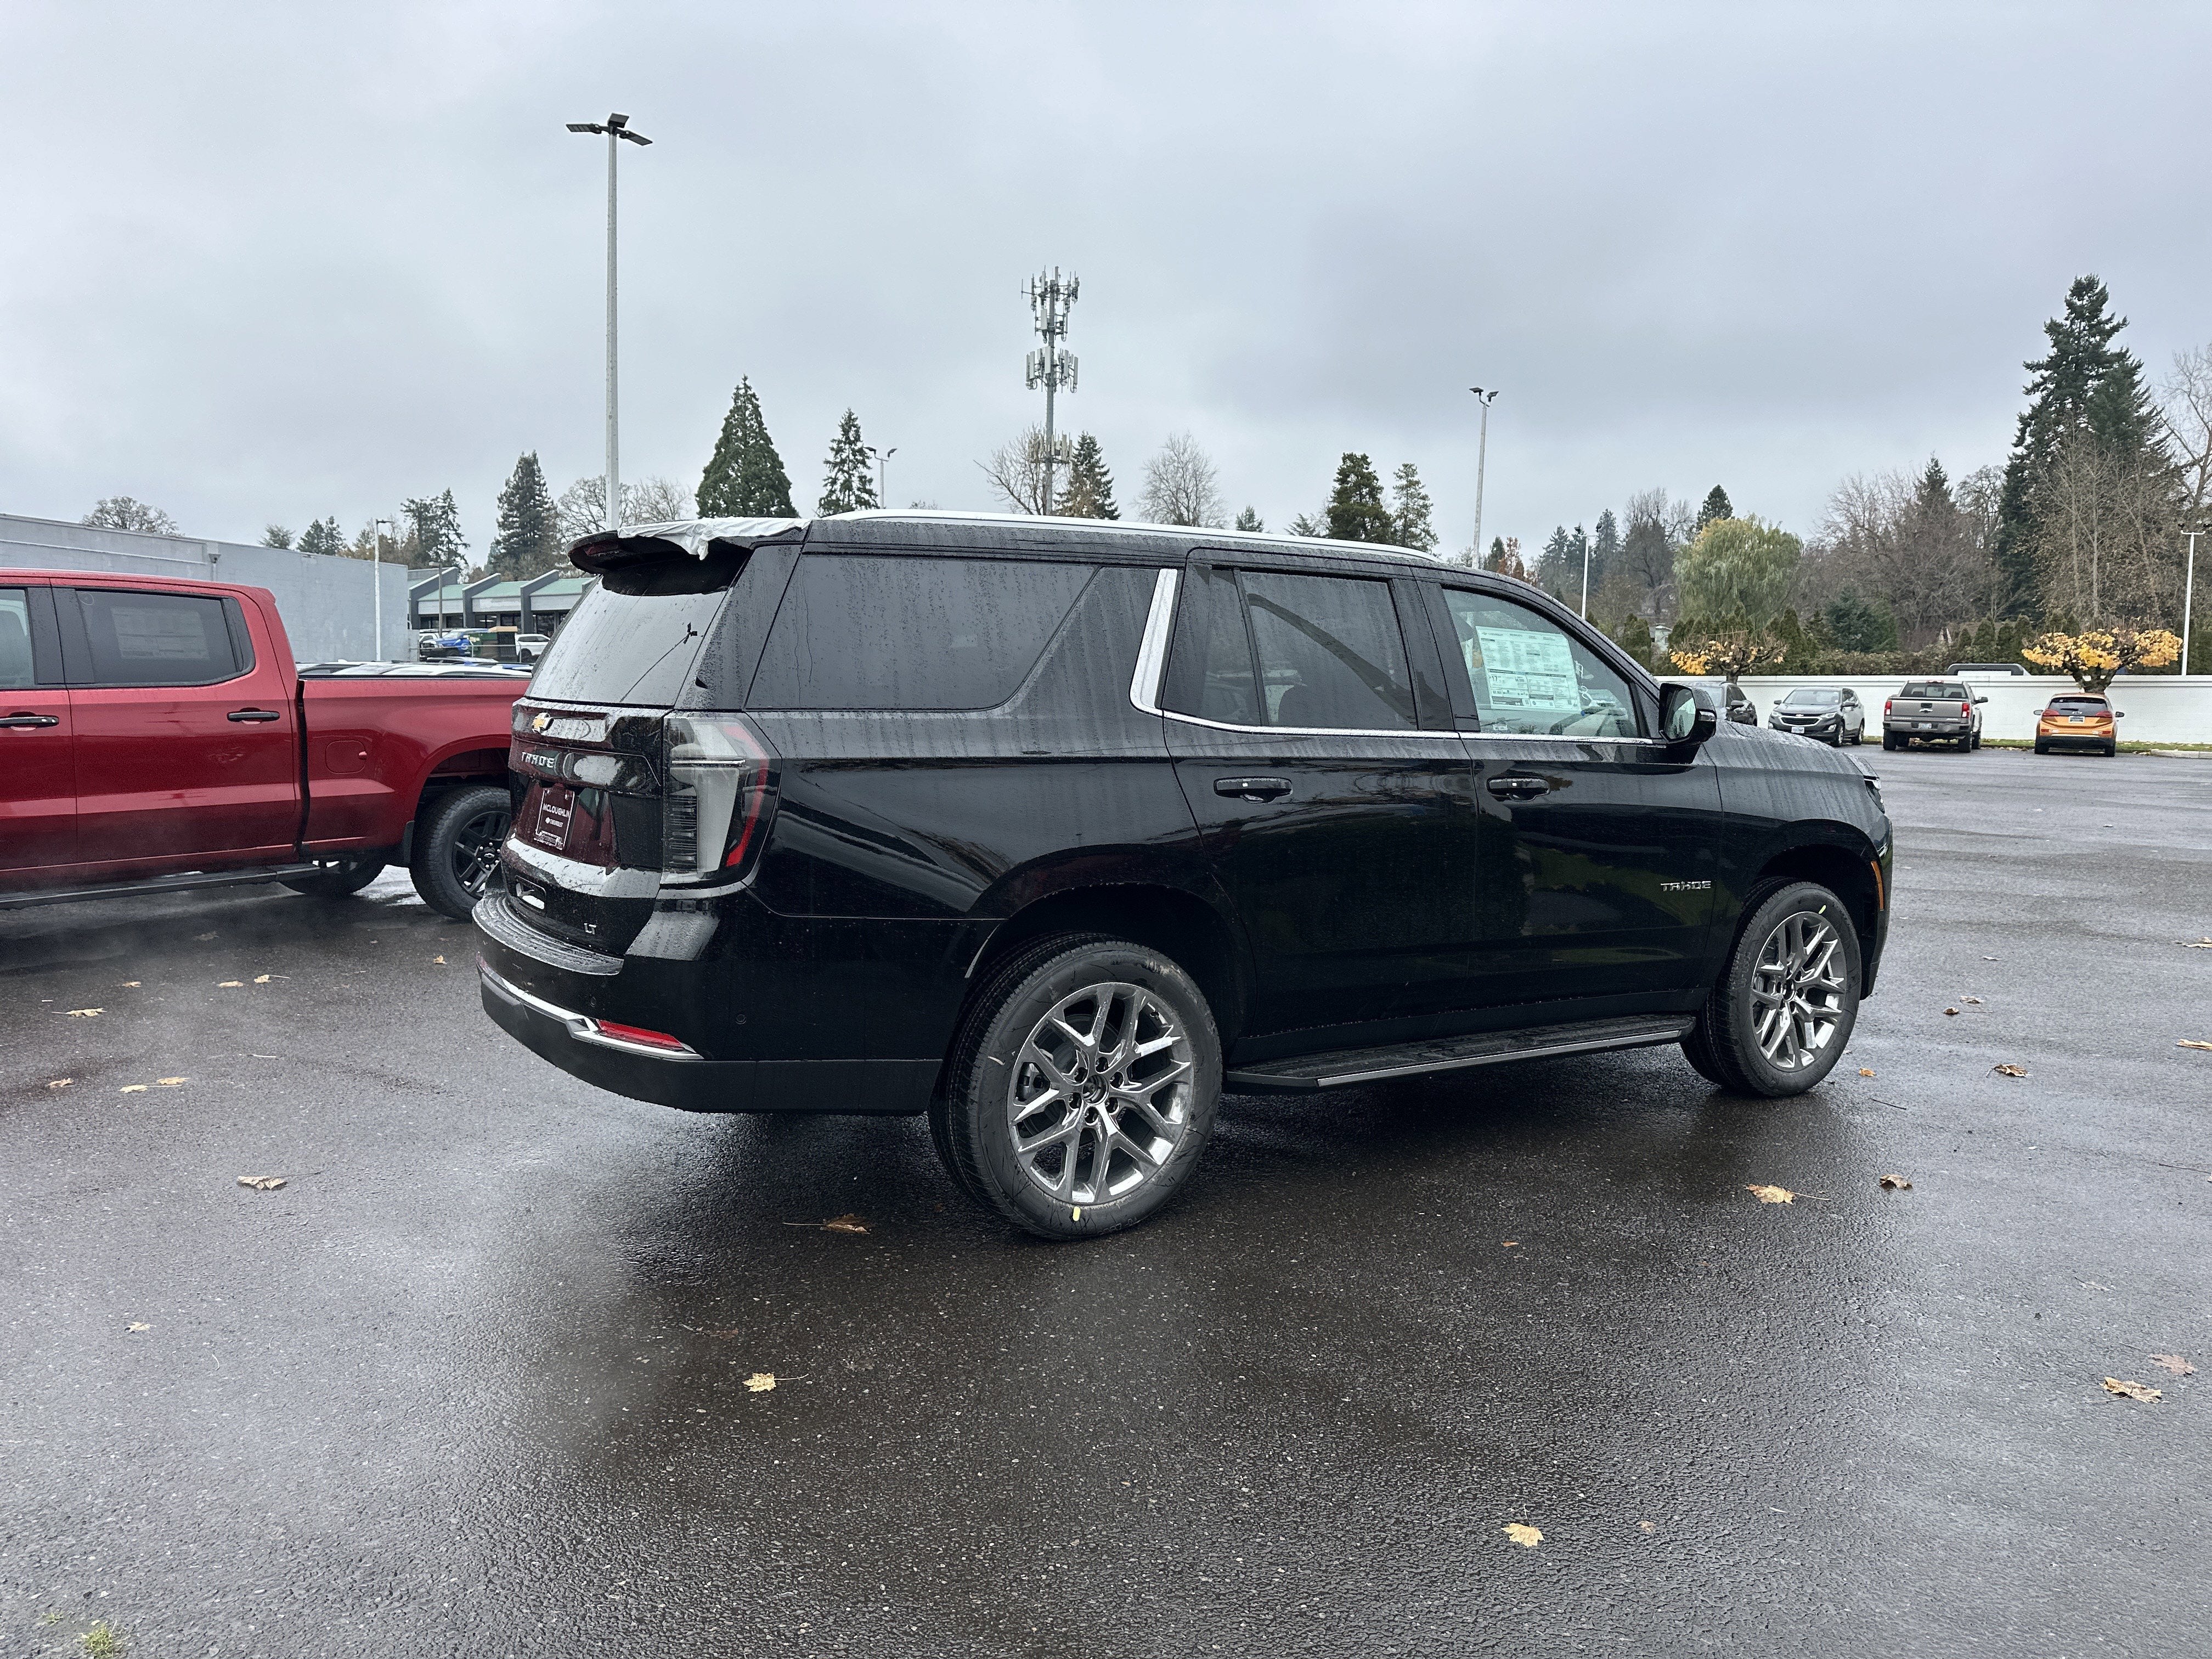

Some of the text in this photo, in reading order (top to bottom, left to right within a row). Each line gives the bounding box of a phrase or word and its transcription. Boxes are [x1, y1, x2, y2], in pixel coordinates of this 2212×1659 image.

[521, 752, 556, 769] TAHOE
[543, 803, 572, 818] MCLOUGHLIN
[1660, 881, 1712, 891] TAHOE
[584, 923, 597, 935] LT
